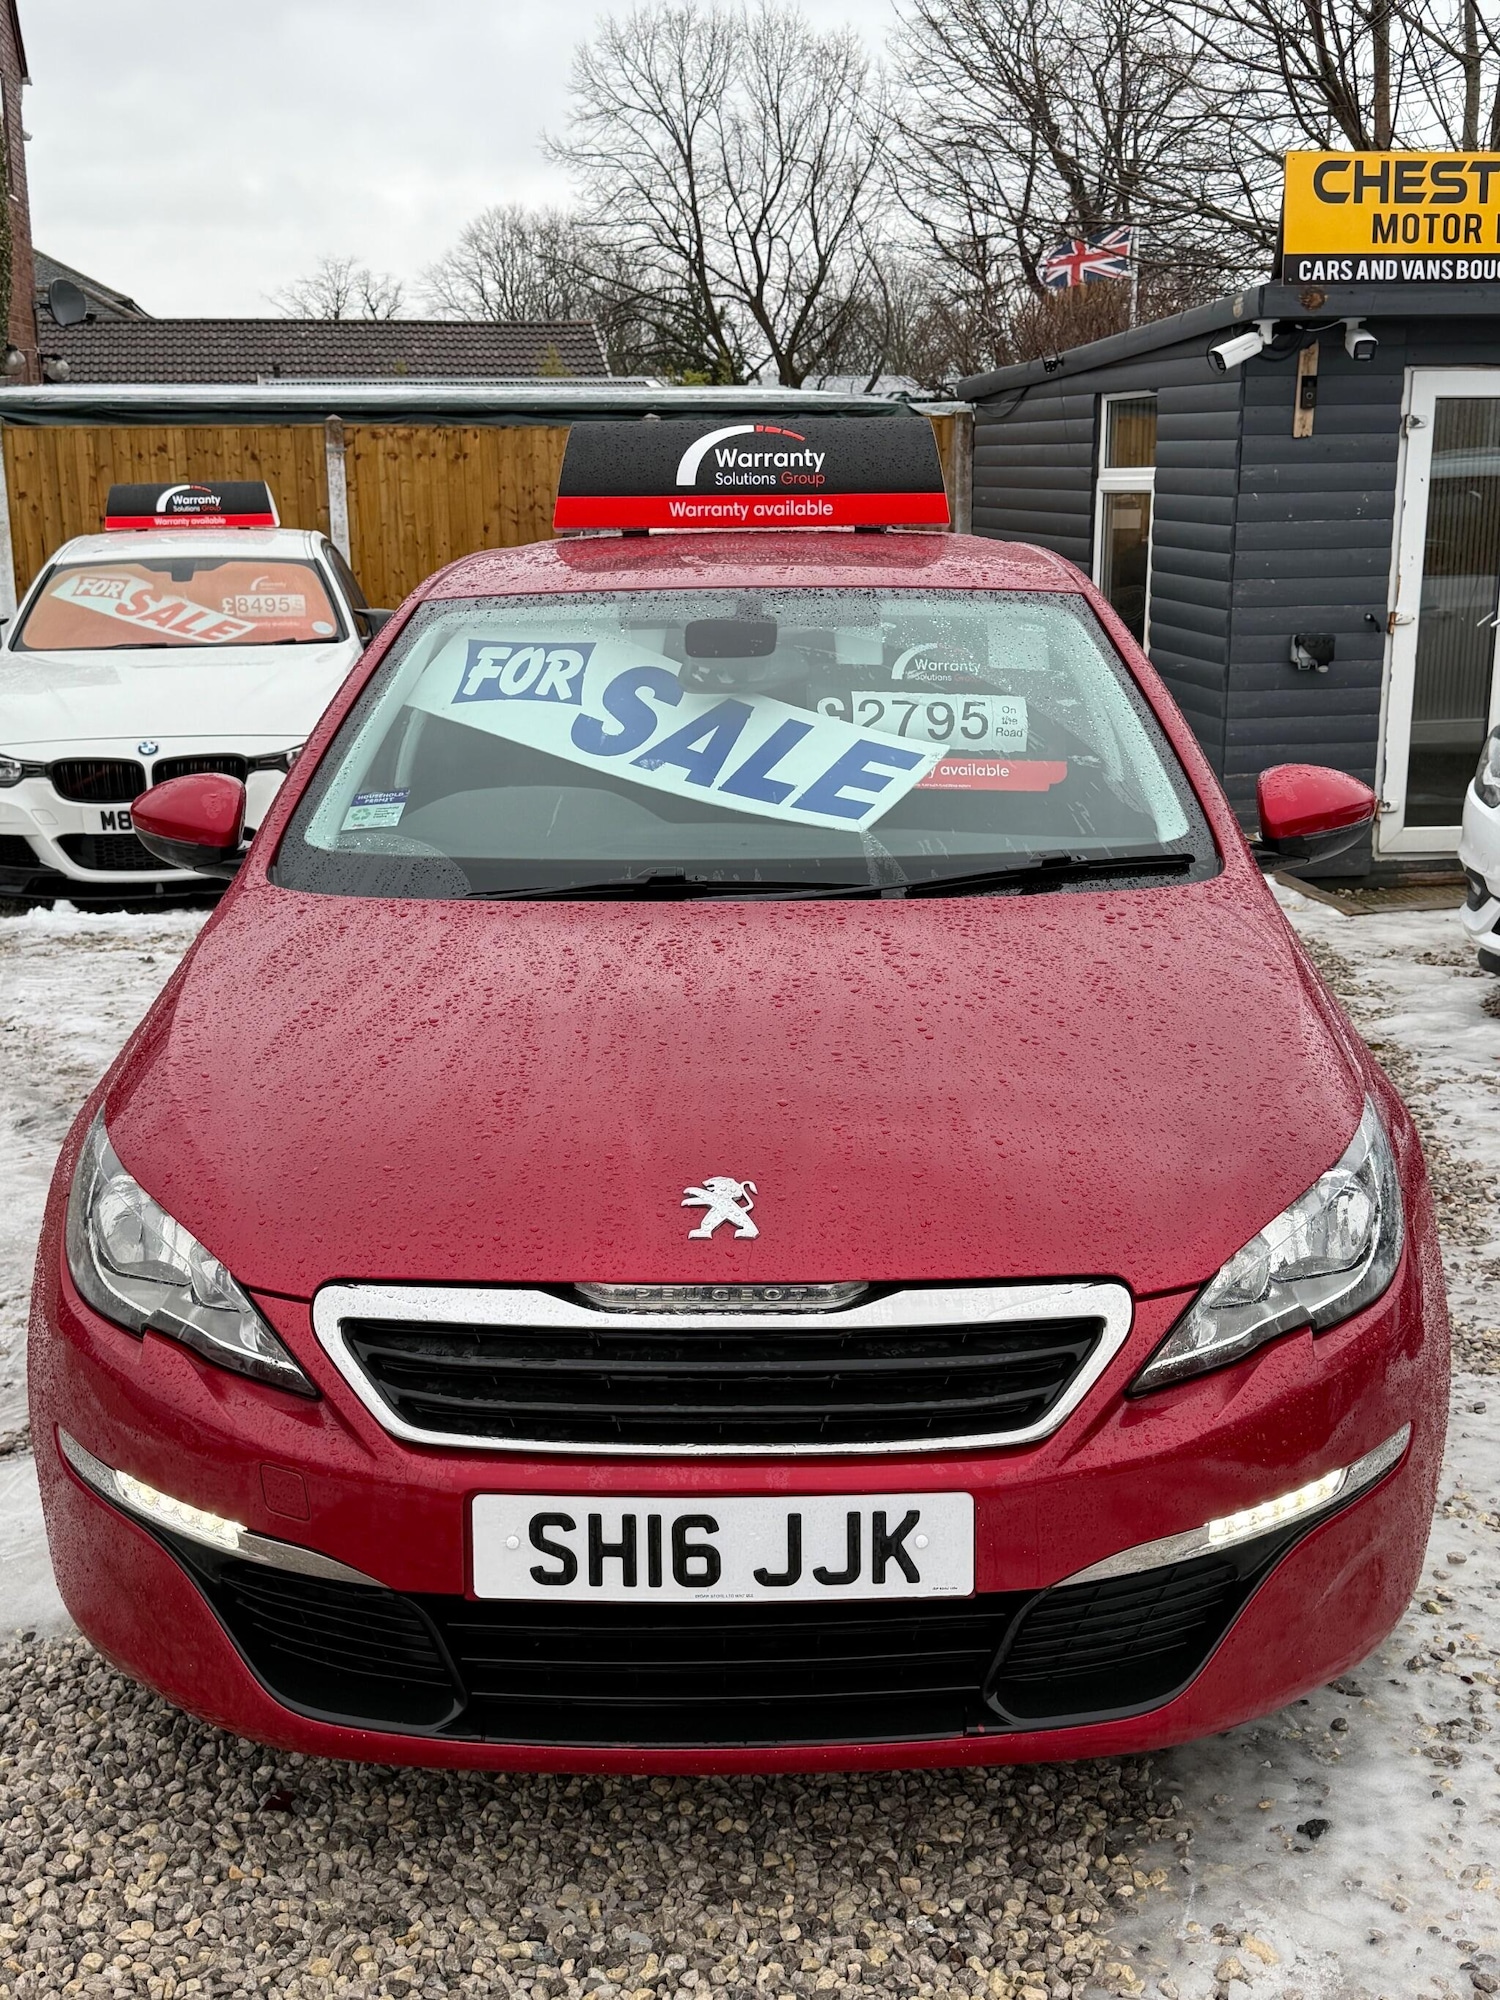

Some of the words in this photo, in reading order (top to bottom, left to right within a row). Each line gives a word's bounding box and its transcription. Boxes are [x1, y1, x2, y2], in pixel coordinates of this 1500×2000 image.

[1314, 160, 1500, 204] CHEST
[1372, 213, 1483, 244] MOTOR
[1299, 260, 1353, 281] CARS
[1356, 260, 1398, 281] AND
[1401, 259, 1454, 281] VANS
[1456, 259, 1500, 280] BOU
[714, 448, 826, 473] Warranty
[714, 472, 777, 486] Solutions
[780, 471, 826, 487] Group
[172, 495, 221, 507] Warranty
[173, 505, 201, 513] Solutions
[201, 504, 222, 512] Group
[669, 501, 750, 520] Warranty
[753, 500, 834, 517] available
[154, 517, 190, 527] Warranty
[191, 515, 227, 525] available
[76, 577, 128, 598] FOR
[222, 597, 290, 615] £8495
[115, 589, 248, 641] SALE
[462, 646, 586, 701] FOR
[914, 658, 981, 675] Warranty
[914, 673, 952, 682] Solutions
[1002, 705, 1017, 714] On
[1002, 715, 1018, 725] the
[996, 726, 1024, 738] Road
[570, 665, 927, 820] SALE
[940, 763, 1010, 778] available
[634, 1287, 808, 1301] PEUGEOT
[528, 1511, 722, 1588] SH16
[753, 1509, 922, 1588] JJK
